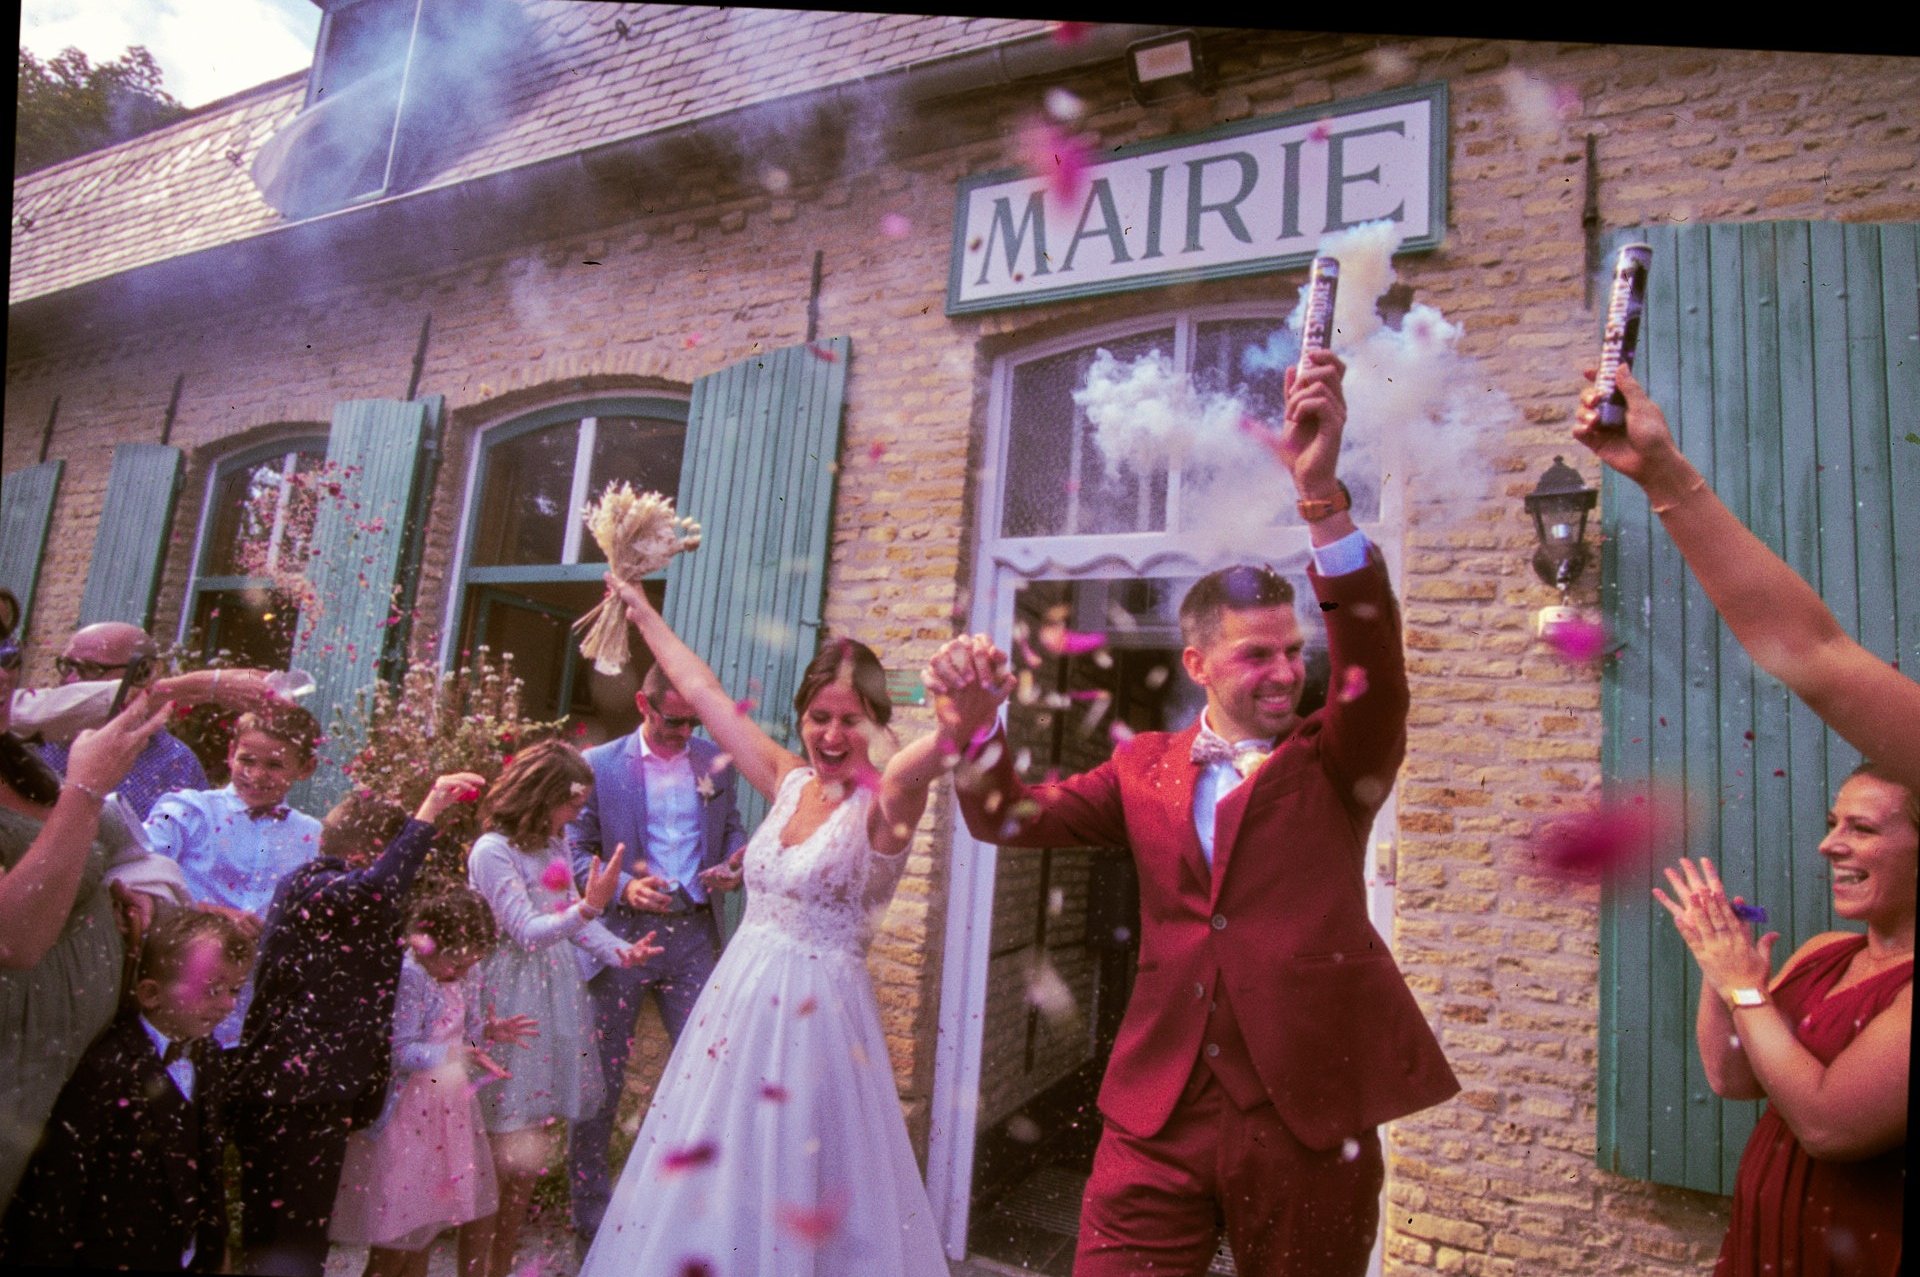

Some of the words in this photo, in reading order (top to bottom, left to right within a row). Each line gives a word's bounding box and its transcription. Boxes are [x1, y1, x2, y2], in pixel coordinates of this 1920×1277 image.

[975, 120, 1405, 286] MAIRIE
[1306, 281, 1331, 333] SMOKE
[1604, 275, 1634, 338] SMOKE
